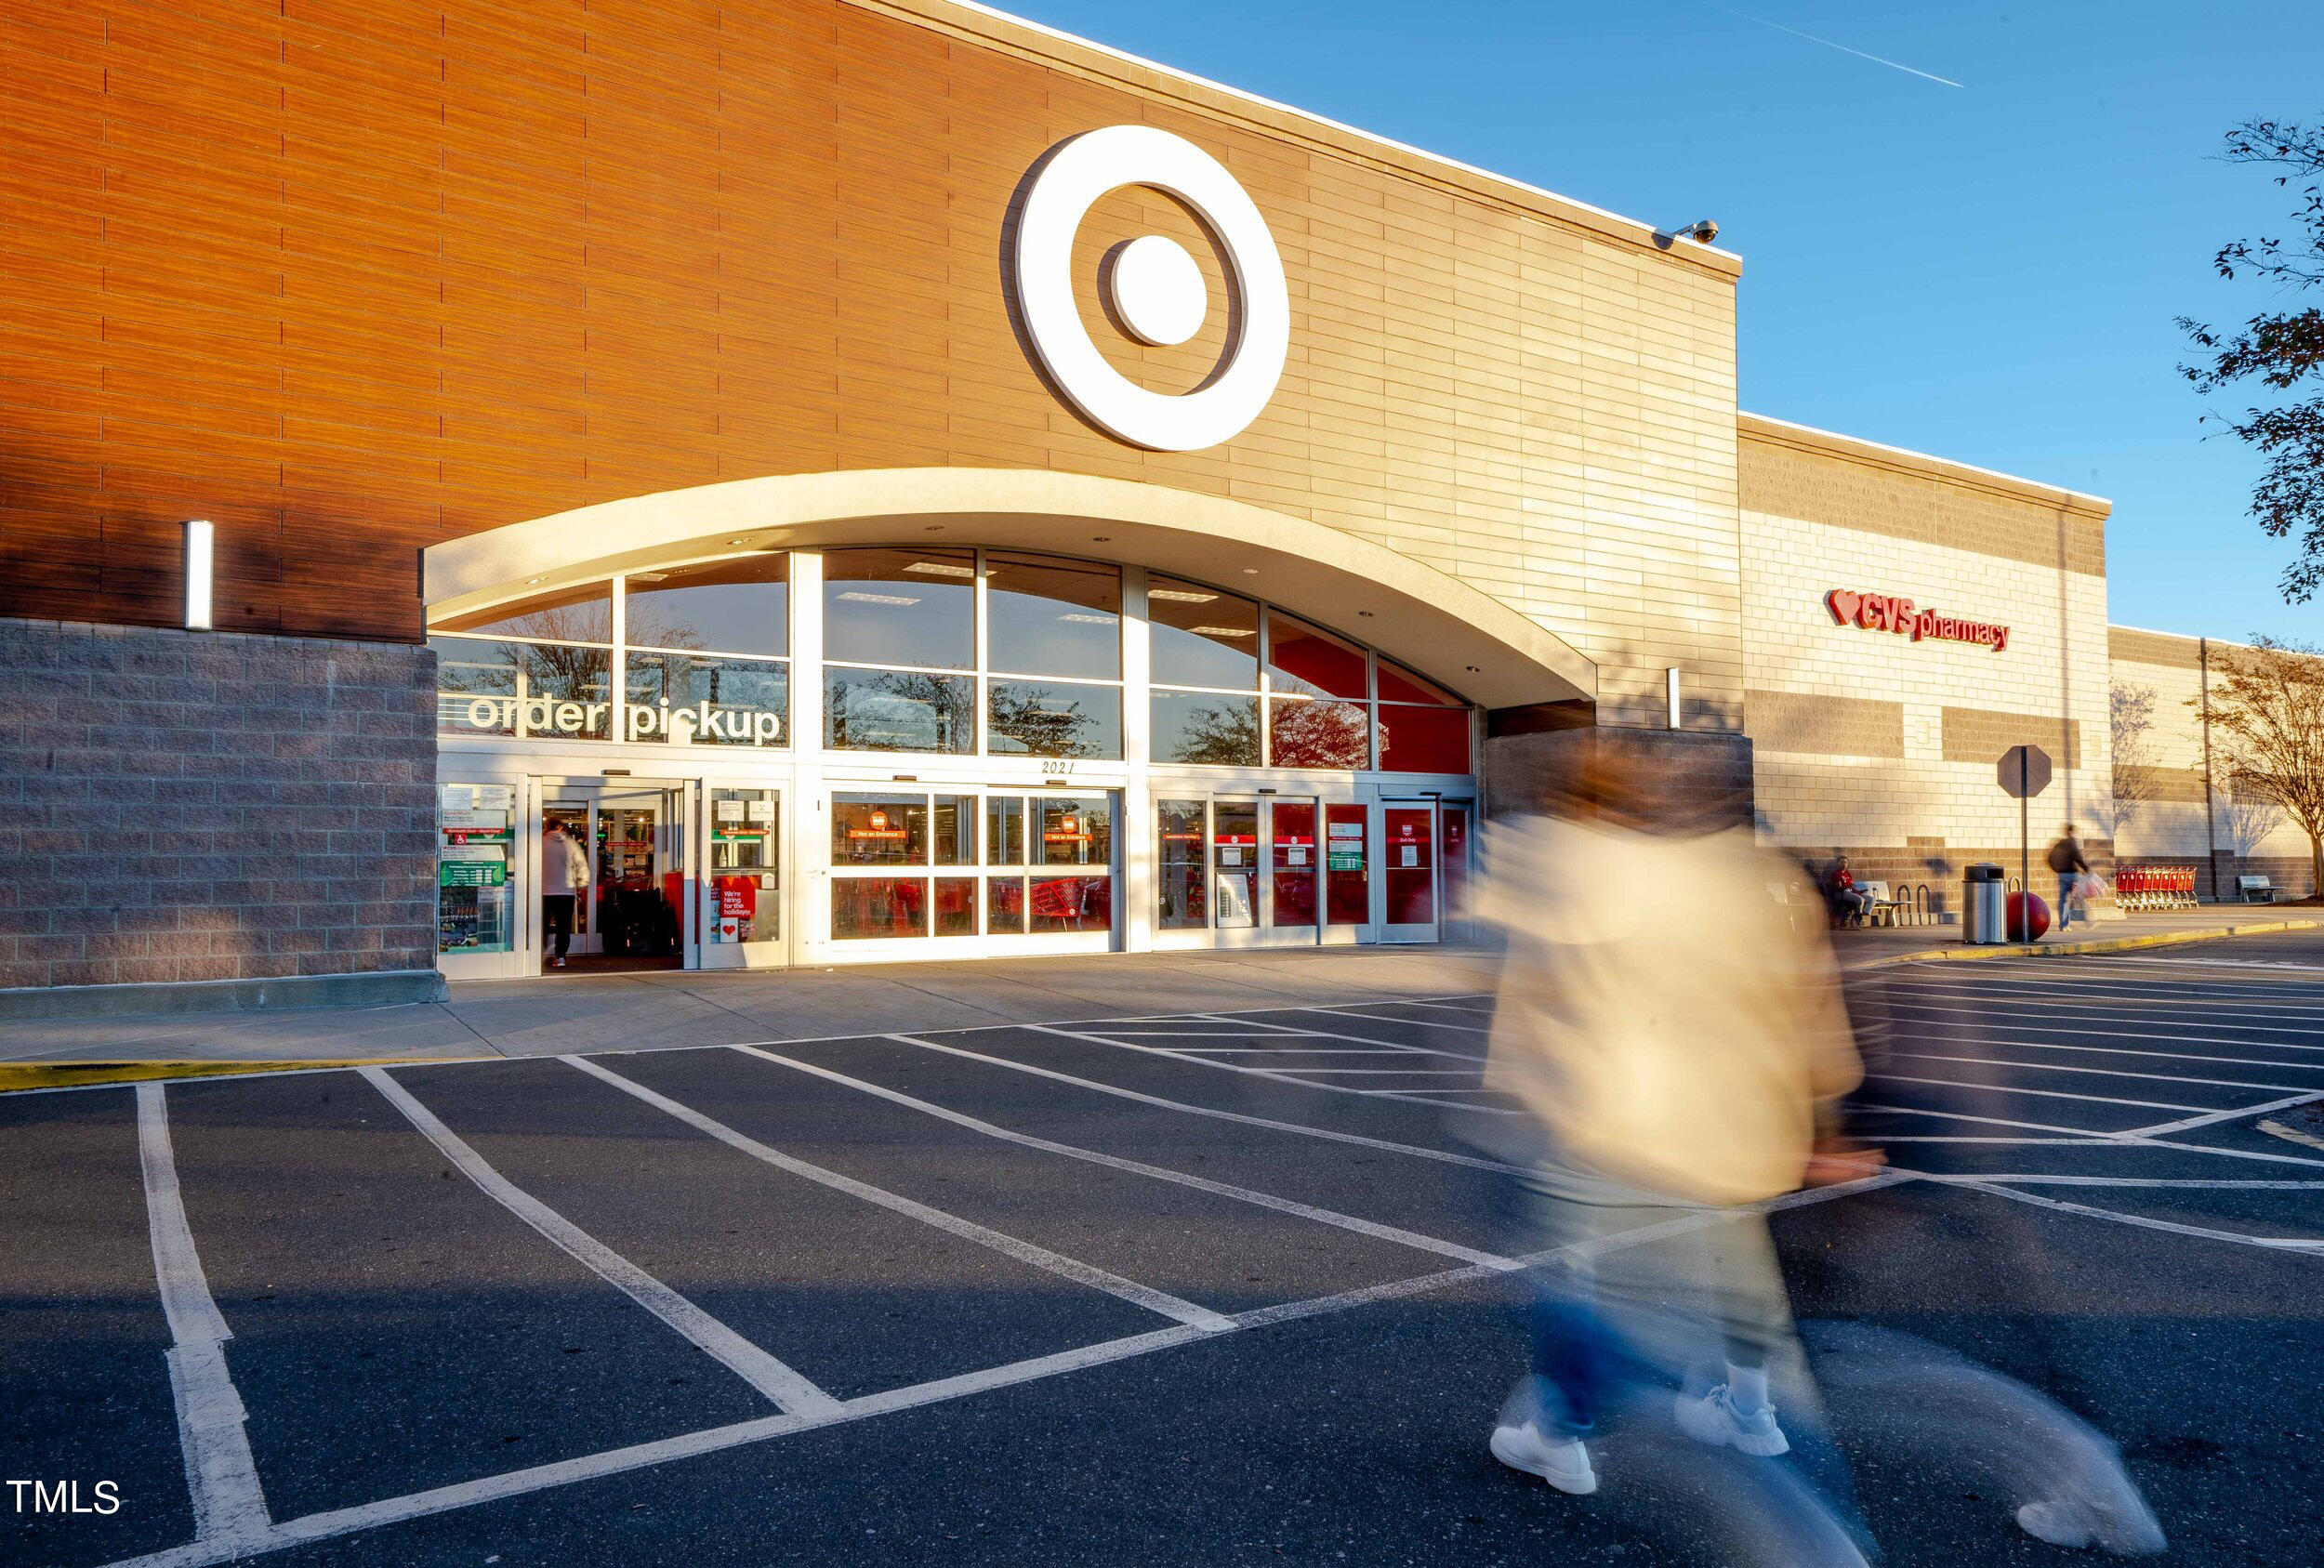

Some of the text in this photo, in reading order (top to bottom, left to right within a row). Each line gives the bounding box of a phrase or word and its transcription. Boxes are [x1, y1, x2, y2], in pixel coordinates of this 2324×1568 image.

[1858, 593, 2011, 652] CVS pharmacy
[468, 692, 781, 745] order pickup
[1042, 762, 1074, 773] 2021
